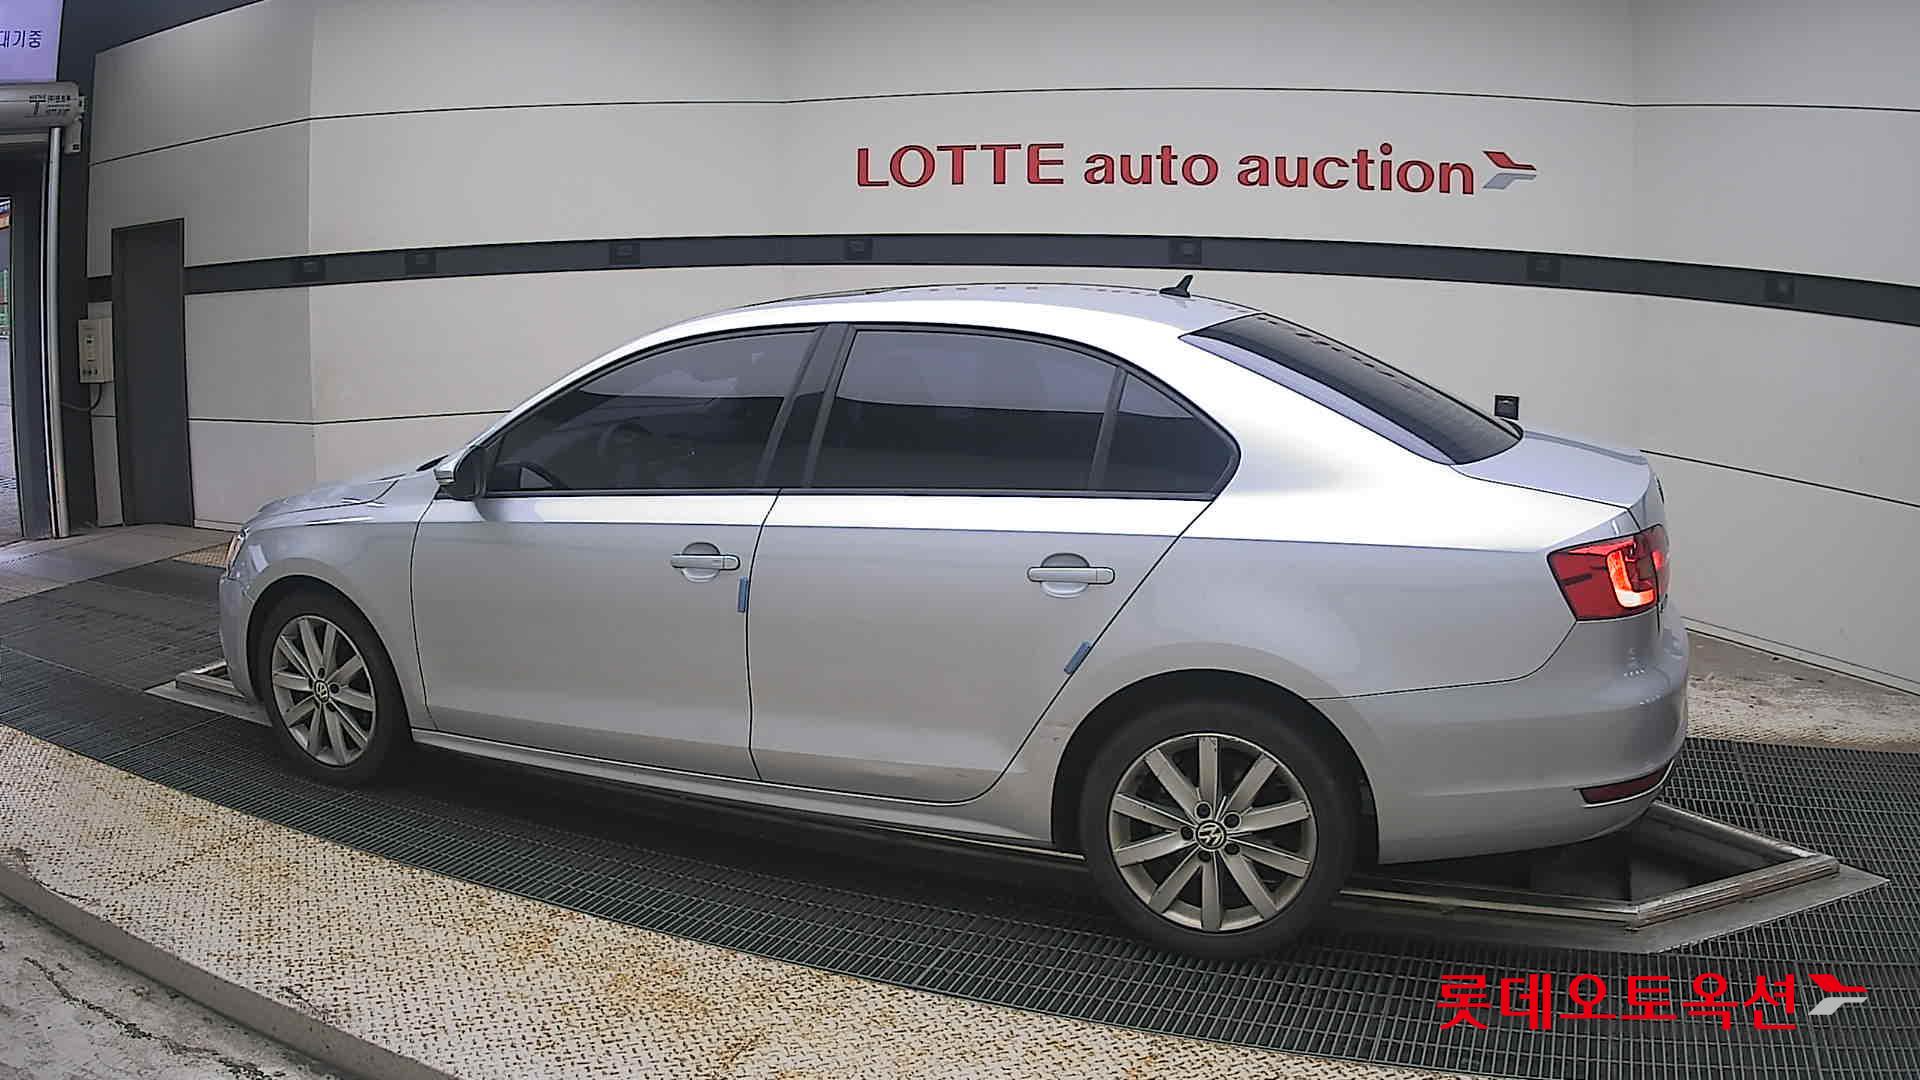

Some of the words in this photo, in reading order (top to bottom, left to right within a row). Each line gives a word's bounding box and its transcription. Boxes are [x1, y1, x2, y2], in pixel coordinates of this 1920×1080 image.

[857, 143, 1063, 188] LOTTE
[1084, 145, 1218, 186] auto
[1237, 143, 1474, 194] auction
